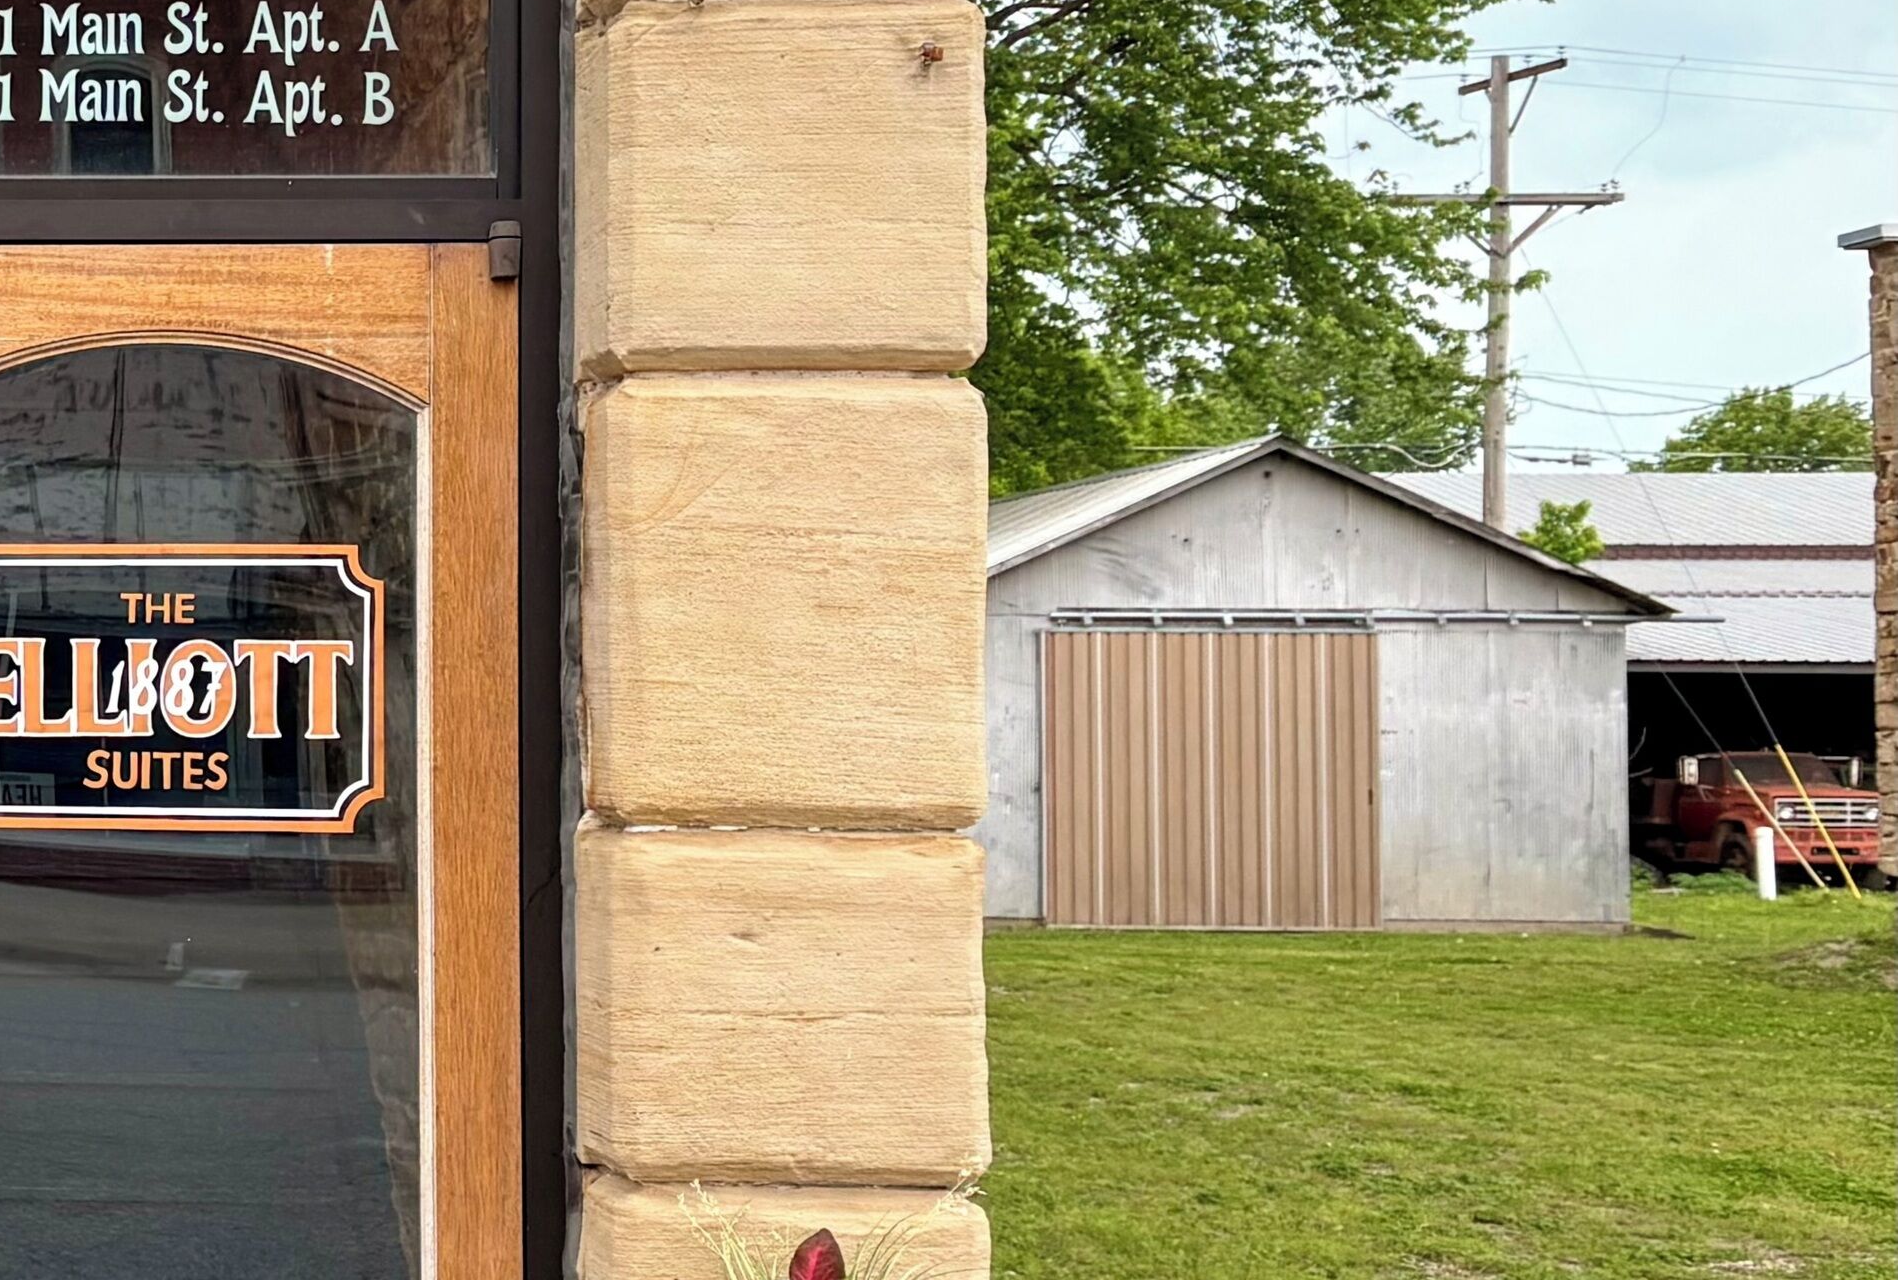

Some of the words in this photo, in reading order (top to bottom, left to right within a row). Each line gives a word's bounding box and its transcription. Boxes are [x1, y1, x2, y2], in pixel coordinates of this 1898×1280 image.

[40, 2, 145, 56] Main
[163, 1, 224, 55] St.
[242, 0, 340, 66] Apt.
[358, 0, 400, 53] A
[39, 68, 144, 122] Main
[163, 69, 224, 123] St.
[243, 70, 343, 137] Apt.
[362, 71, 395, 125] B
[120, 592, 195, 624] THE
[105, 658, 228, 716] 1887
[82, 749, 230, 790] SUITES
